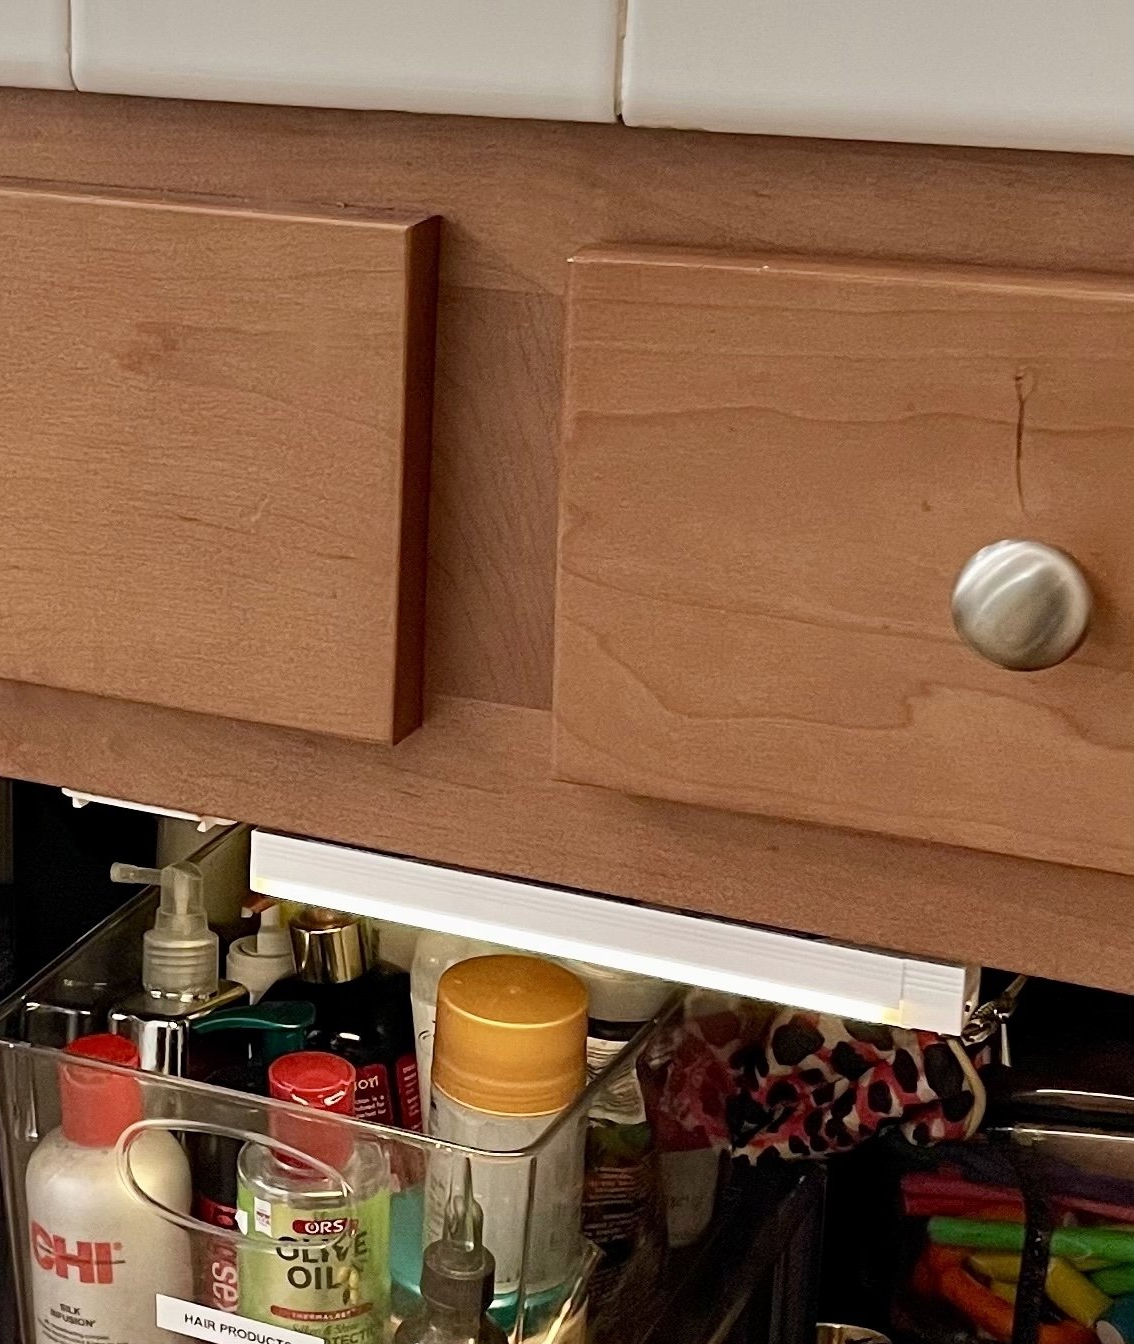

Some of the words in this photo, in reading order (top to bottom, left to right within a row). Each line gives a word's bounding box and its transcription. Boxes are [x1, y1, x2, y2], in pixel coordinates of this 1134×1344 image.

[304, 1219, 344, 1234] ORS
[31, 1220, 113, 1284] CHI
[276, 1231, 368, 1263] OLIVE
[287, 1266, 341, 1290] OIL
[184, 1313, 216, 1332] HAIR
